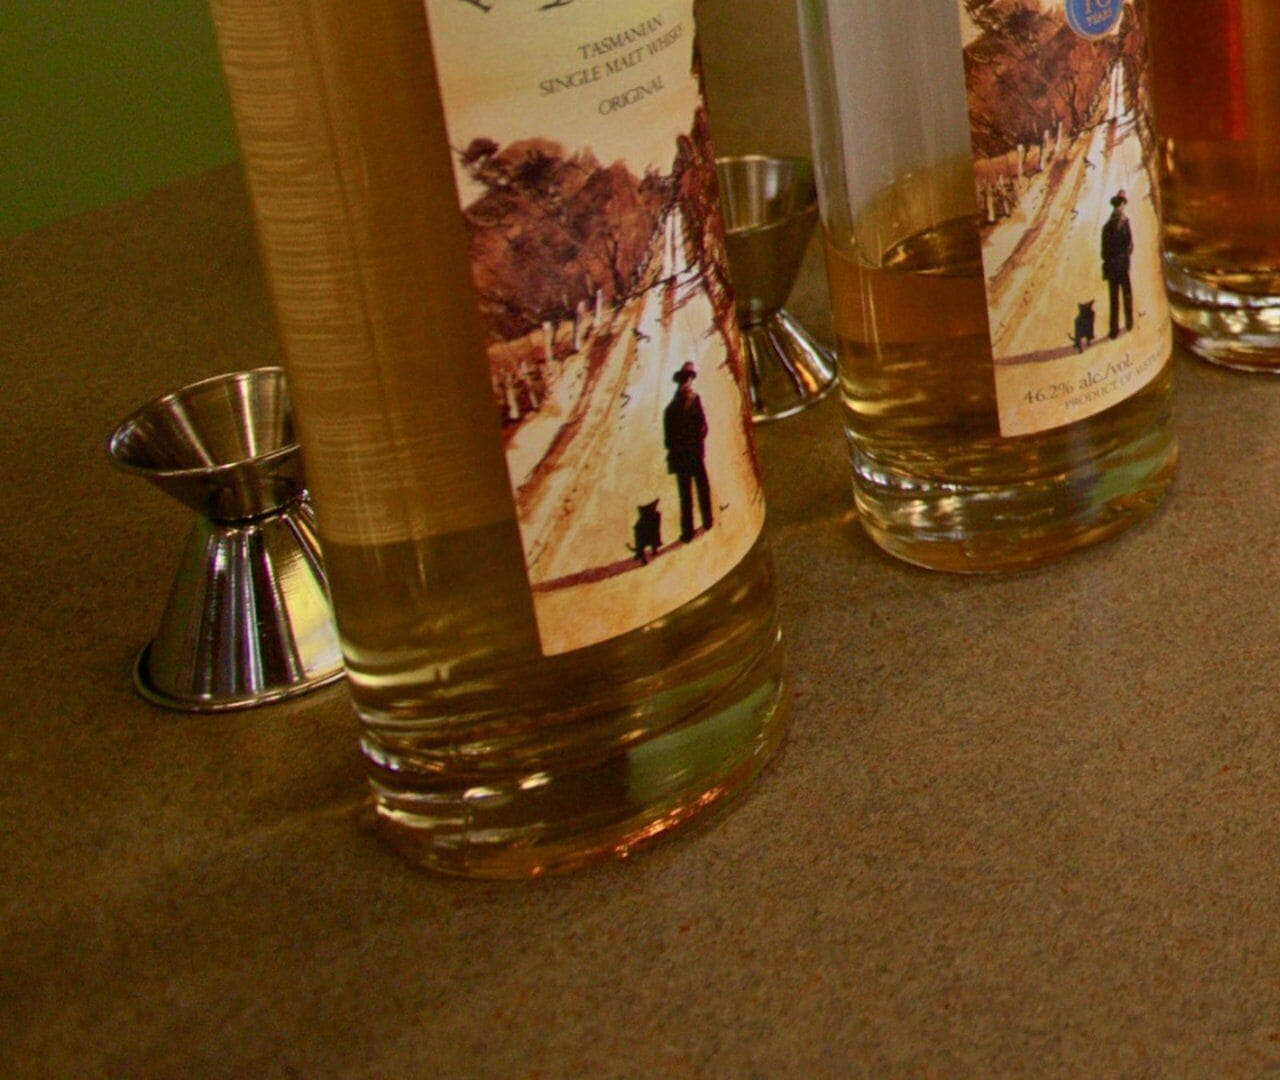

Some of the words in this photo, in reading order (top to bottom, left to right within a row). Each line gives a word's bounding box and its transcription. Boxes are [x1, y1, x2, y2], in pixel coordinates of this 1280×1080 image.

[577, 15, 663, 60] TASMANIAN
[538, 64, 601, 97] SINGLE
[605, 46, 644, 77] MALT
[598, 74, 664, 115] ORIGINAL
